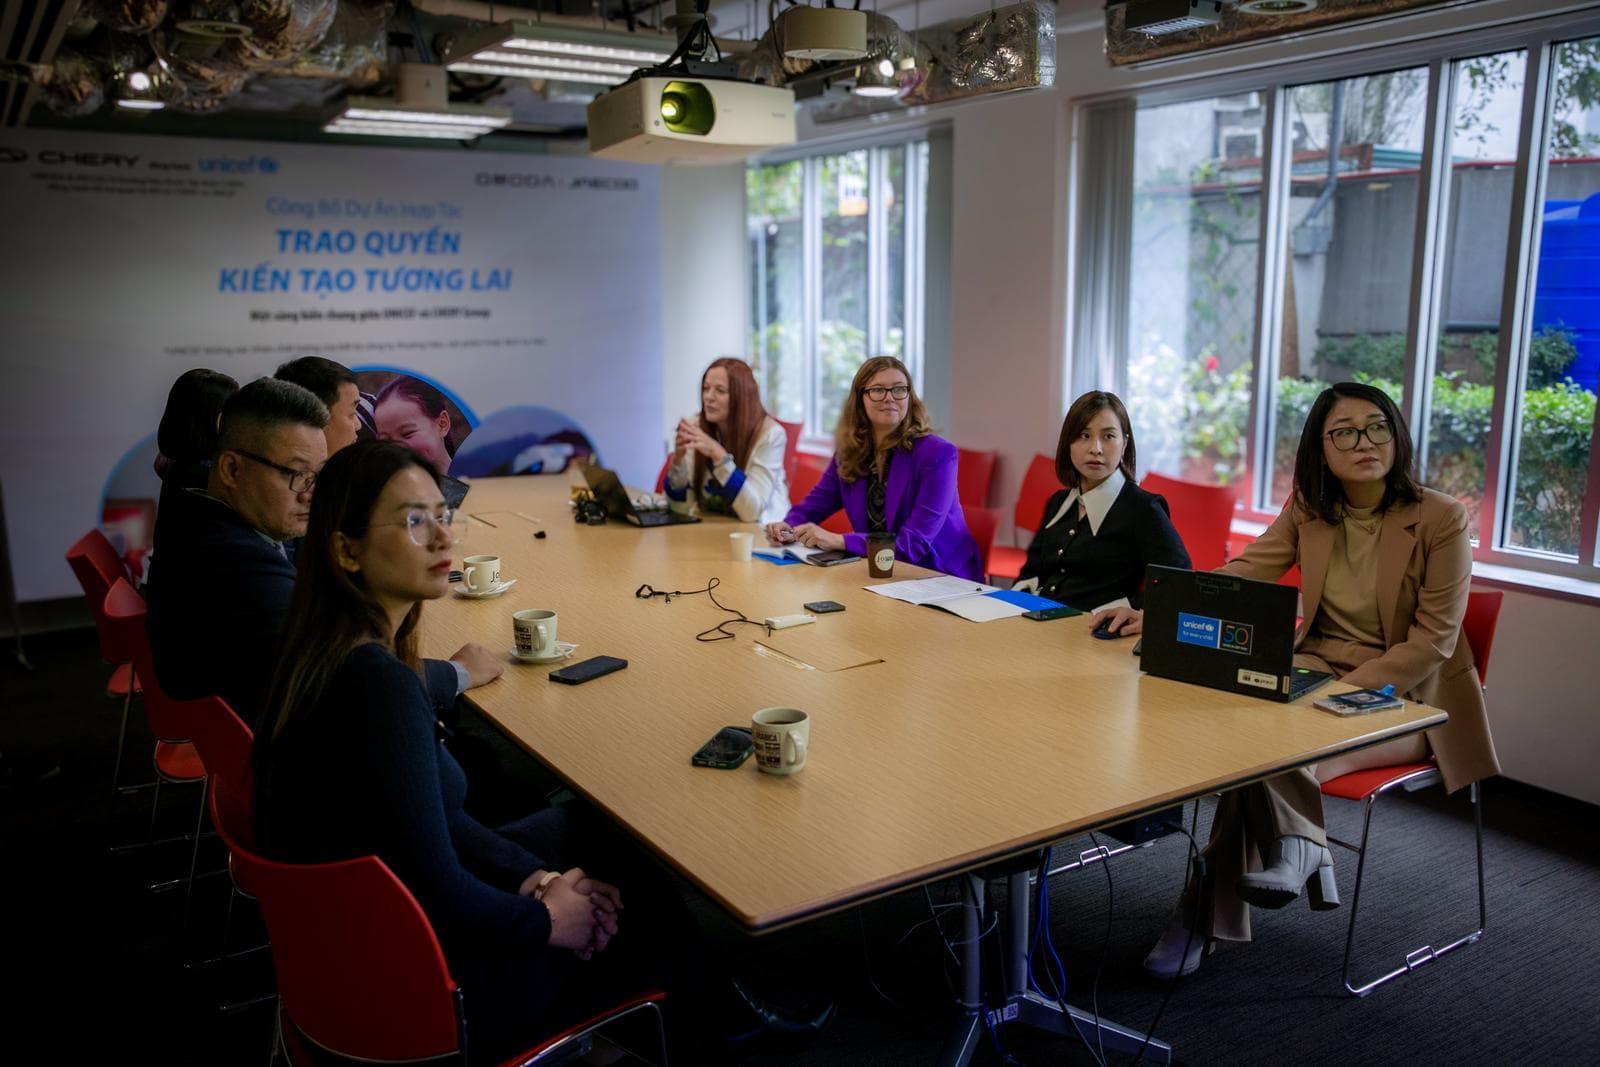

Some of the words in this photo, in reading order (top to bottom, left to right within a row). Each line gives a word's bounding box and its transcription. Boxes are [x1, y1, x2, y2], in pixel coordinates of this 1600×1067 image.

[38, 150, 139, 167] CHERY
[199, 154, 256, 174] unicef
[276, 229, 355, 254] TRAO
[219, 261, 291, 292] KIẾN
[299, 268, 356, 300] TẠO
[366, 265, 464, 293] TƯƠNG
[470, 269, 512, 292] LAI
[1183, 620, 1205, 631] unicef
[1223, 624, 1249, 646] 50
